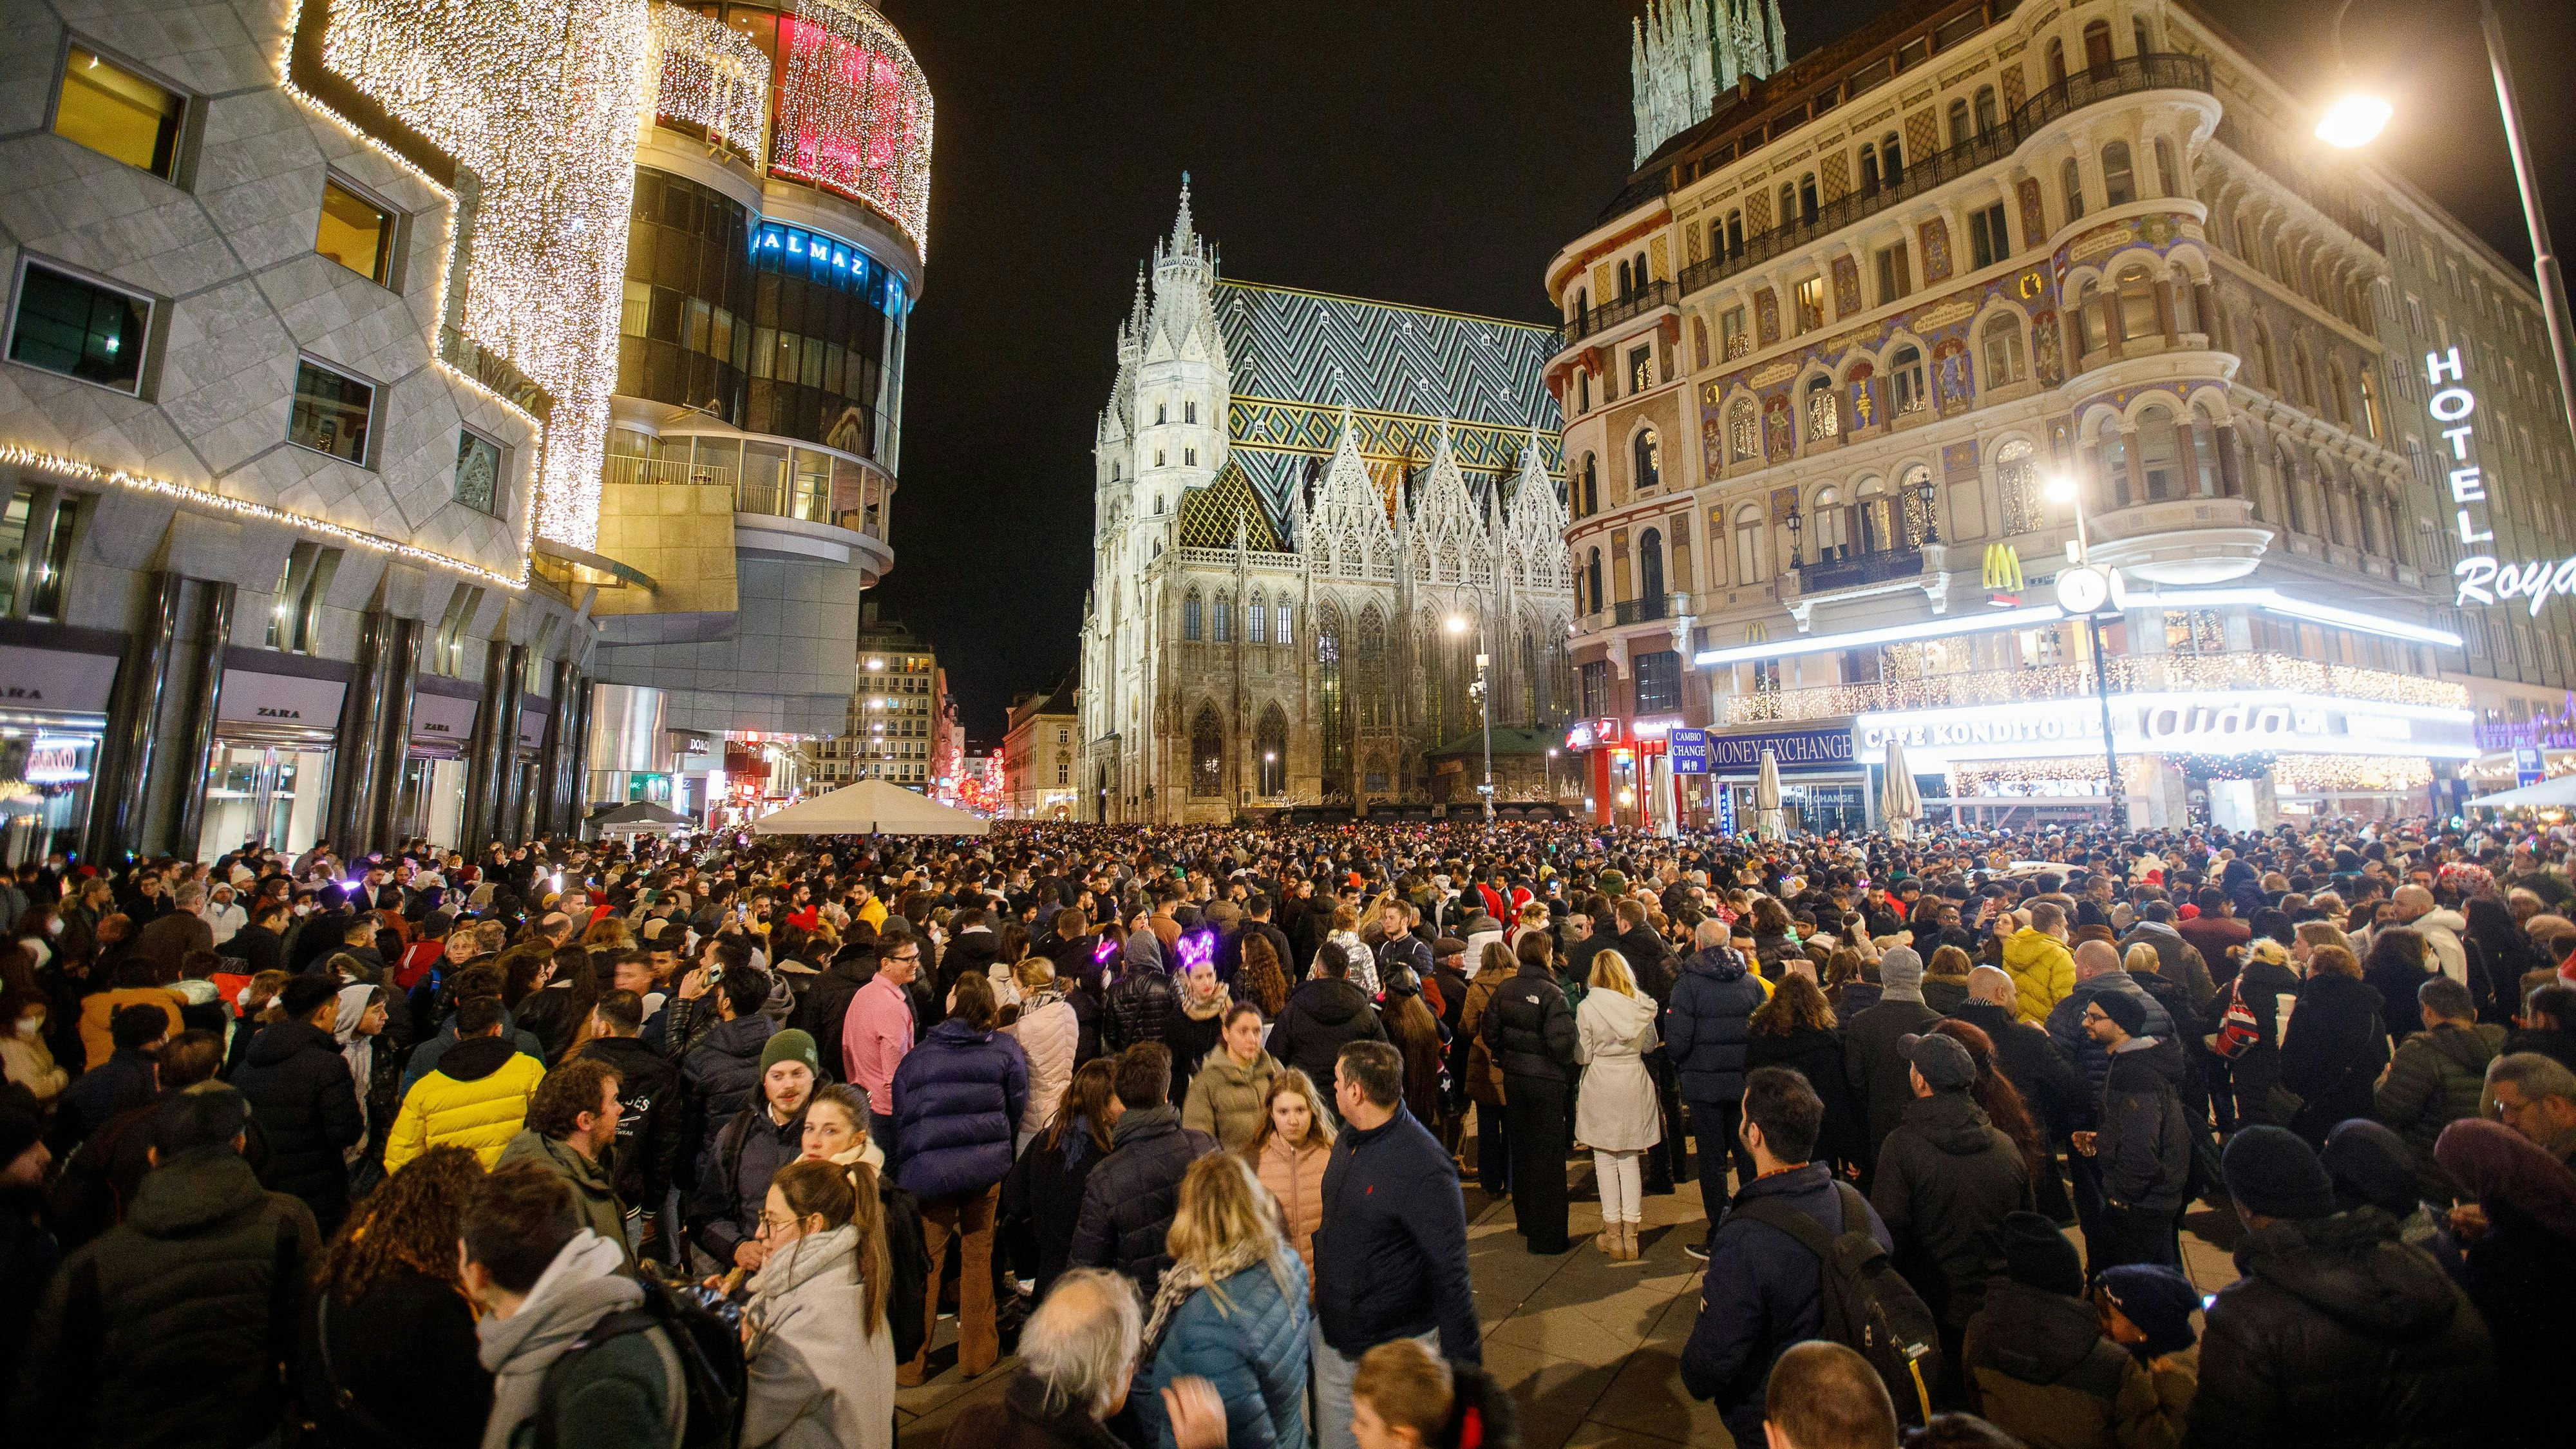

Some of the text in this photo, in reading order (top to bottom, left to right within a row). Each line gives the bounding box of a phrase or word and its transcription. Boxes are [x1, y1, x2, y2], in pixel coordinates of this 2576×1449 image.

[764, 234, 862, 274] ALMAZ
[2426, 346, 2493, 544] HOTEL
[258, 708, 300, 719] ZARA
[424, 723, 450, 732] ZARA
[1676, 732, 1701, 741] CAMBIO
[1673, 744, 1705, 757] CHANGE
[1710, 734, 1853, 764] MONEY EXCHANGE
